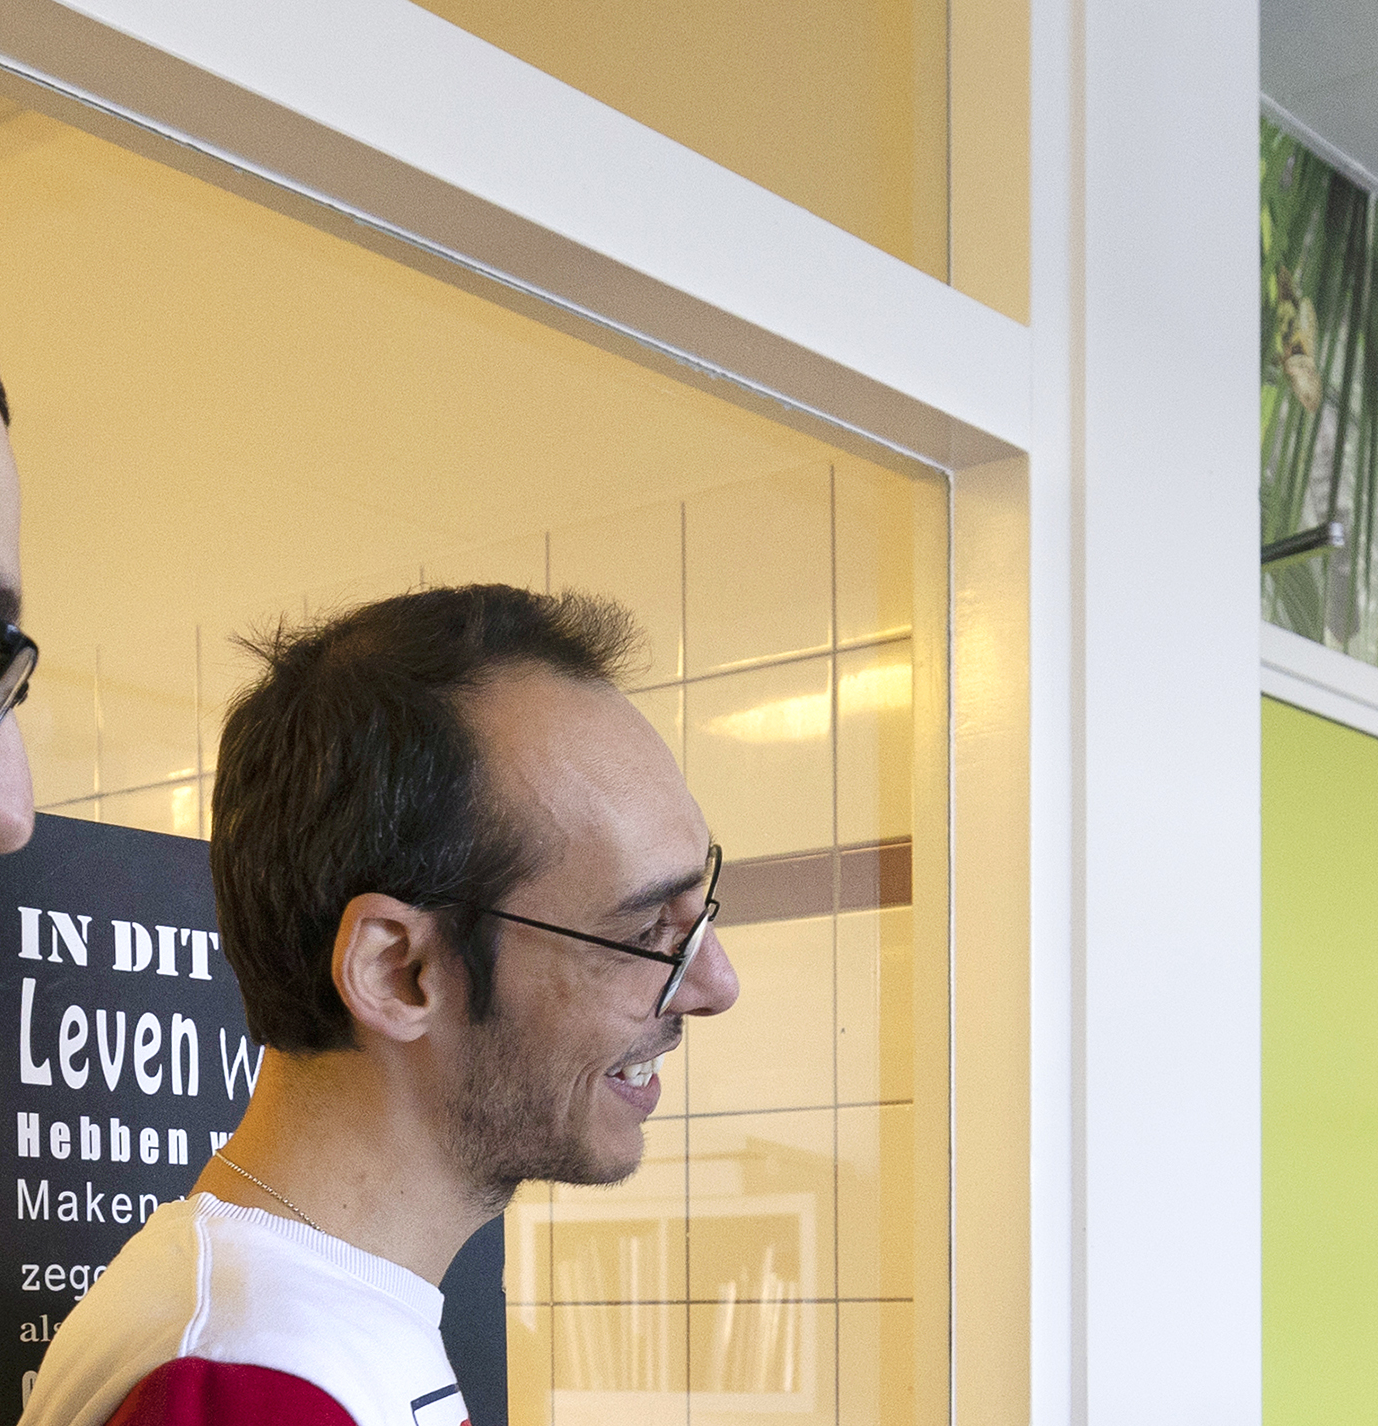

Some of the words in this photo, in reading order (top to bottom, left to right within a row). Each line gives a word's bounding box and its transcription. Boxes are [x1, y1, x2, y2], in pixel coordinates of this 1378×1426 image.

[17, 905, 93, 967] IN
[111, 919, 220, 981] DIT
[19, 977, 200, 1098] Leven
[17, 1111, 189, 1165] Hebben
[17, 1178, 159, 1224] Maken
